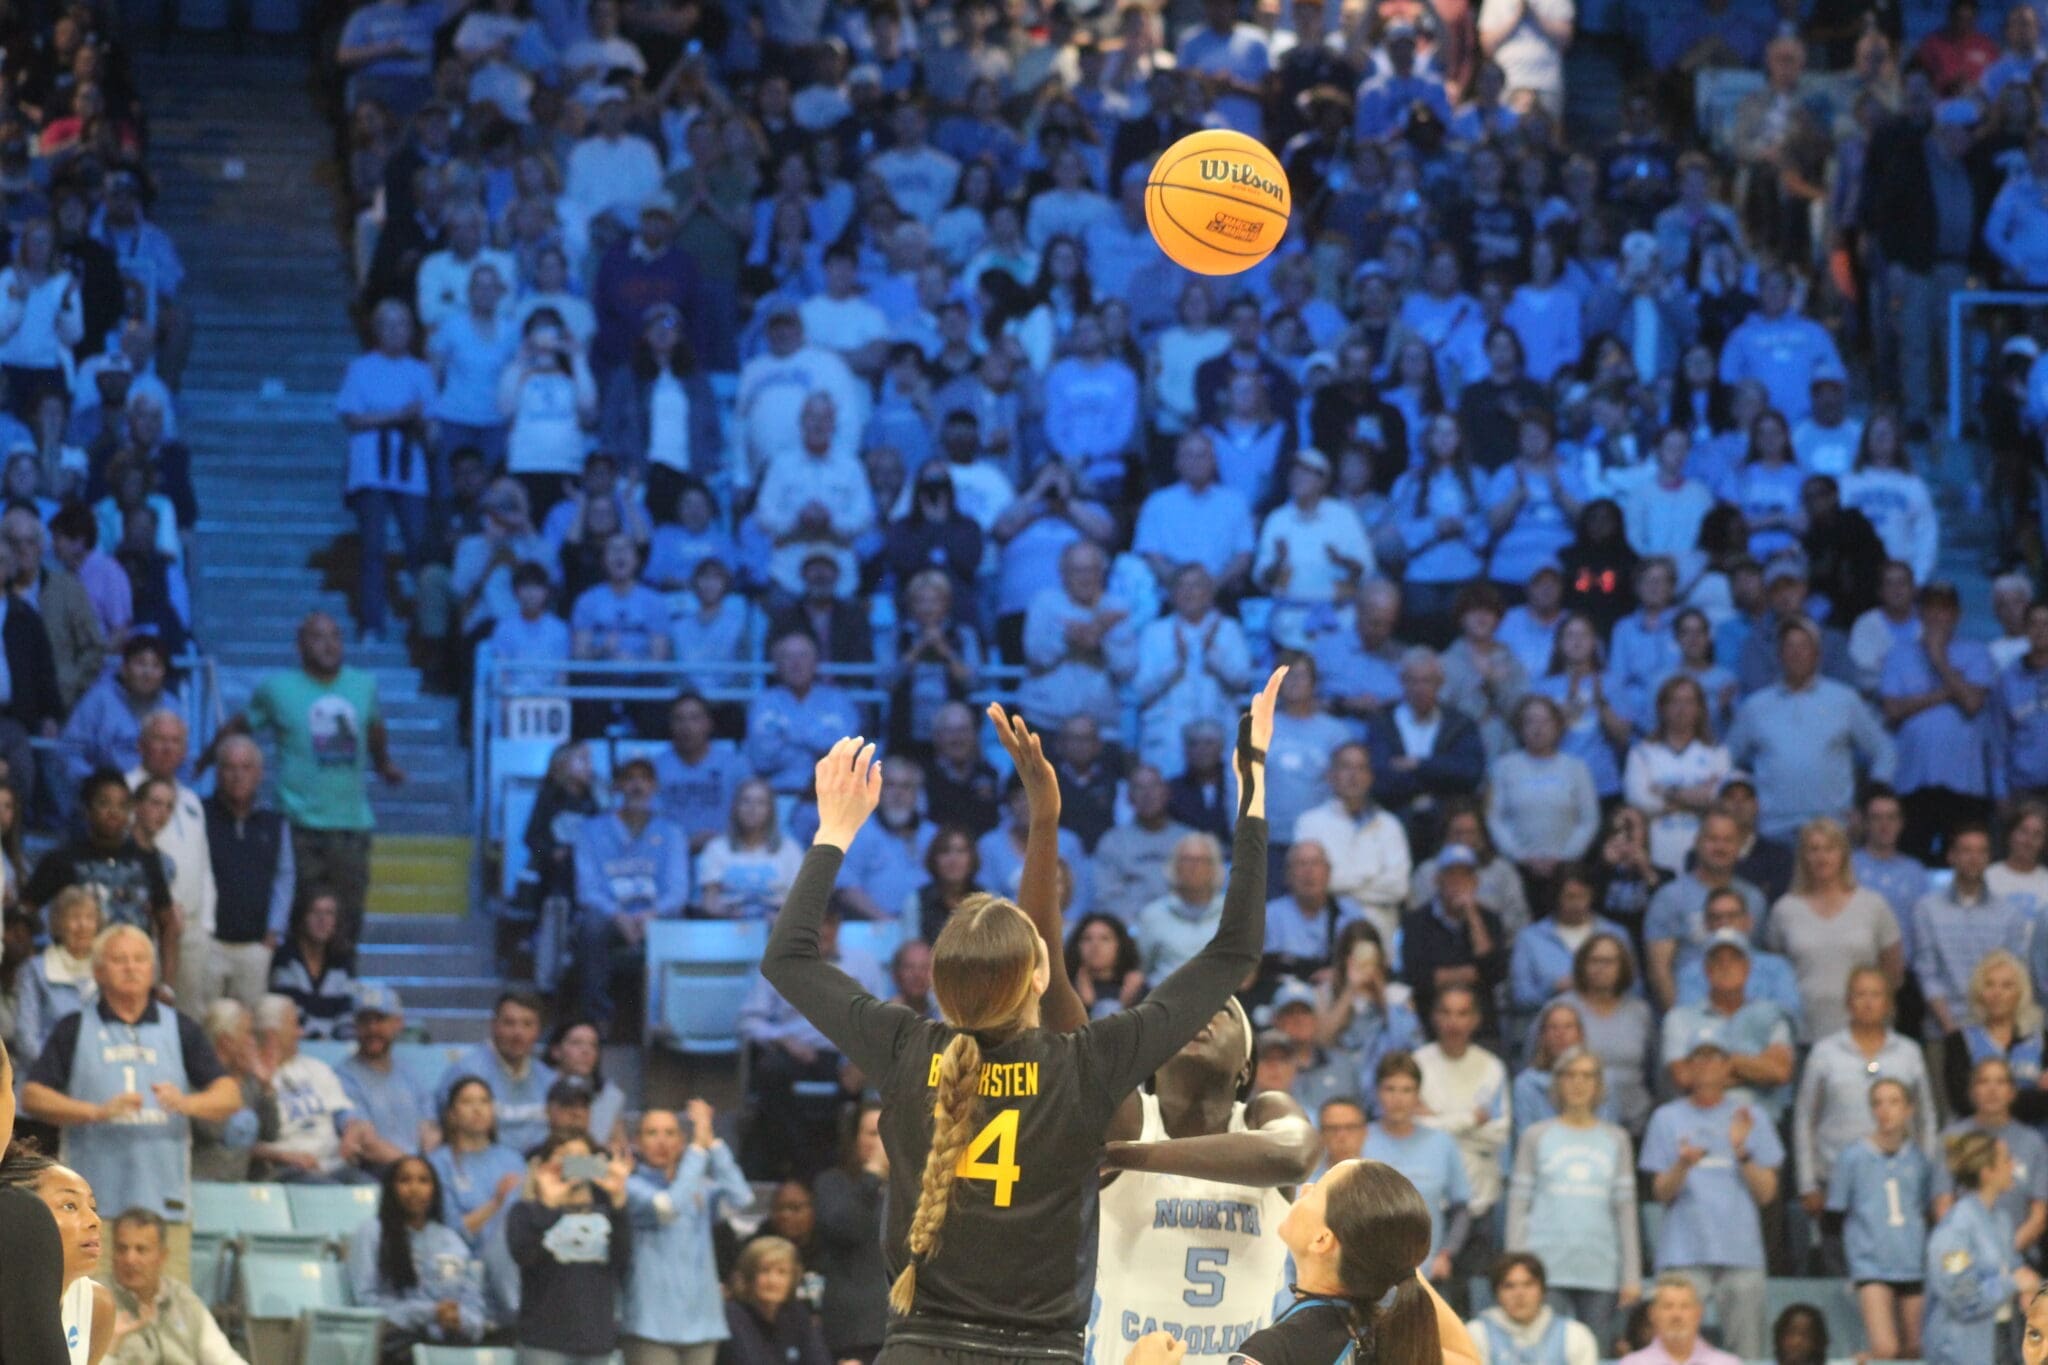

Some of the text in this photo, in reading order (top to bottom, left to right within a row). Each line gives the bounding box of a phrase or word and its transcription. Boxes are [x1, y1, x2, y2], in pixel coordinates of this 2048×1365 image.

[1200, 159, 1283, 203] Wilson
[519, 706, 563, 735] 110
[927, 1053, 1039, 1097] BKSTEN
[1153, 1198, 1261, 1236] NORTH
[1884, 1178, 1905, 1228] 1
[1183, 1247, 1229, 1307] 5
